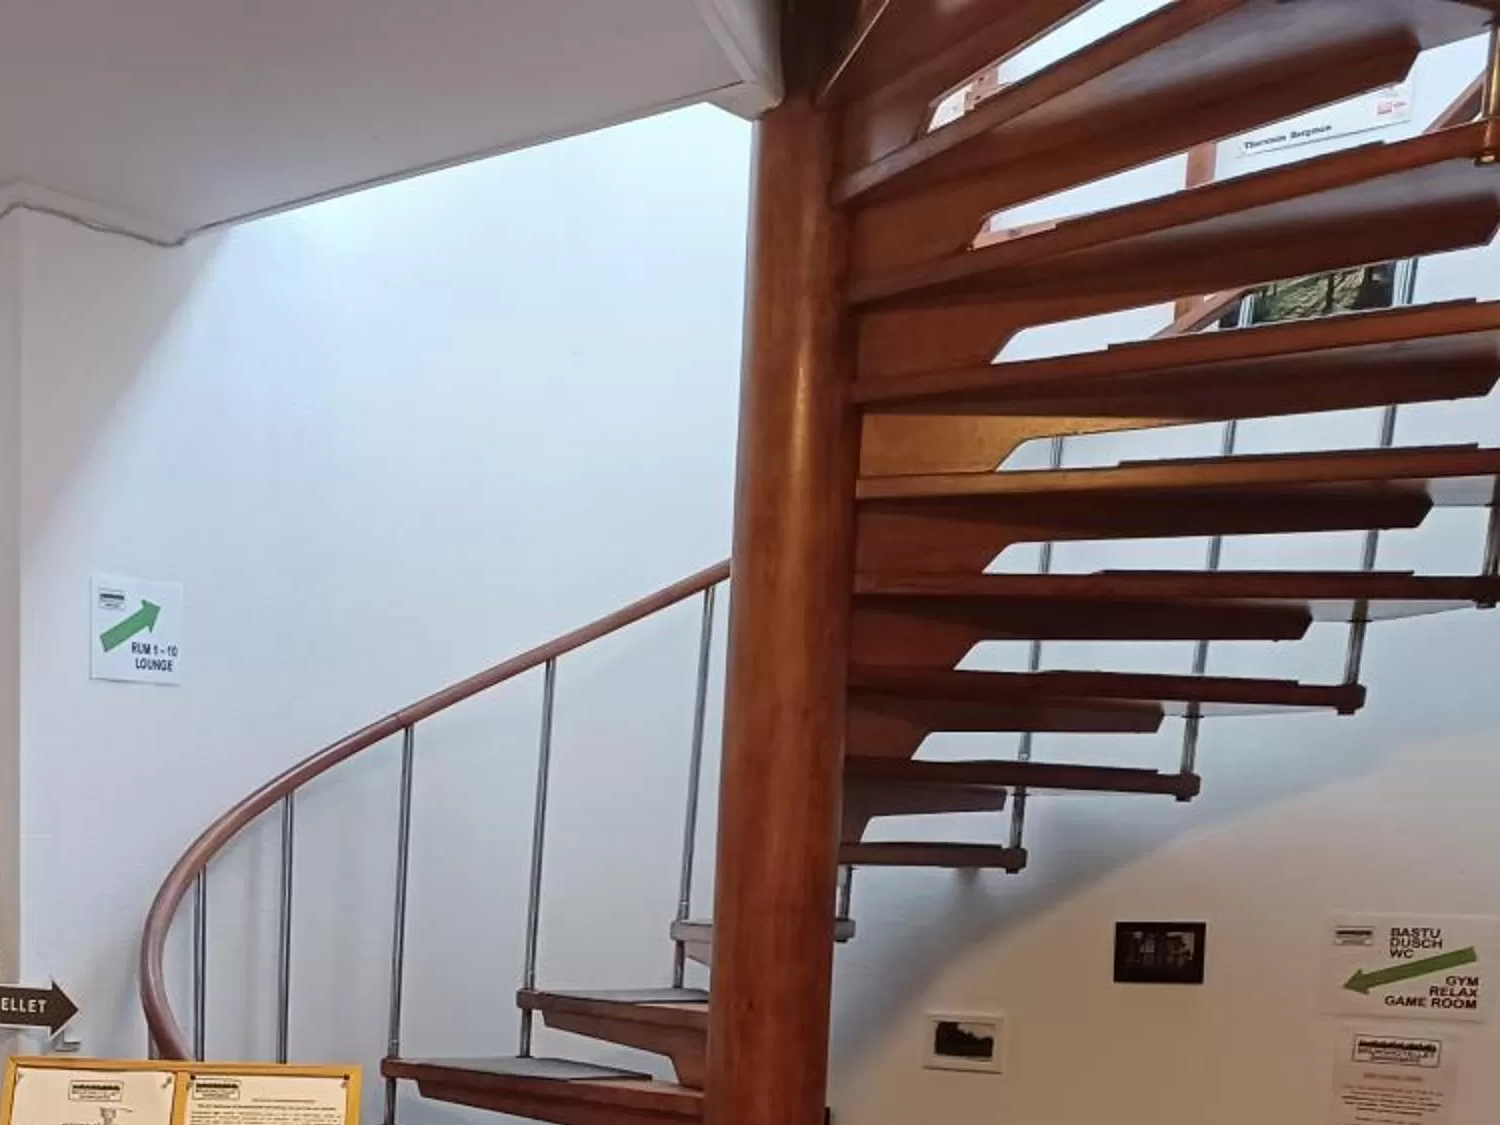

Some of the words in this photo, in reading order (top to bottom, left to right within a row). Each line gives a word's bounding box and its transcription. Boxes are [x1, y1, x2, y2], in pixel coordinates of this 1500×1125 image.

[131, 641, 151, 654] RUM
[167, 645, 178, 657] 10
[135, 657, 173, 672] LOUNGE
[1390, 927, 1441, 939] BASTU
[1390, 937, 1443, 949] DUSCH
[1390, 949, 1414, 959] WC
[1445, 975, 1479, 987] GYM
[1429, 986, 1477, 998] RELAX
[1384, 995, 1427, 1007] GAME
[1431, 998, 1477, 1009] ROOM
